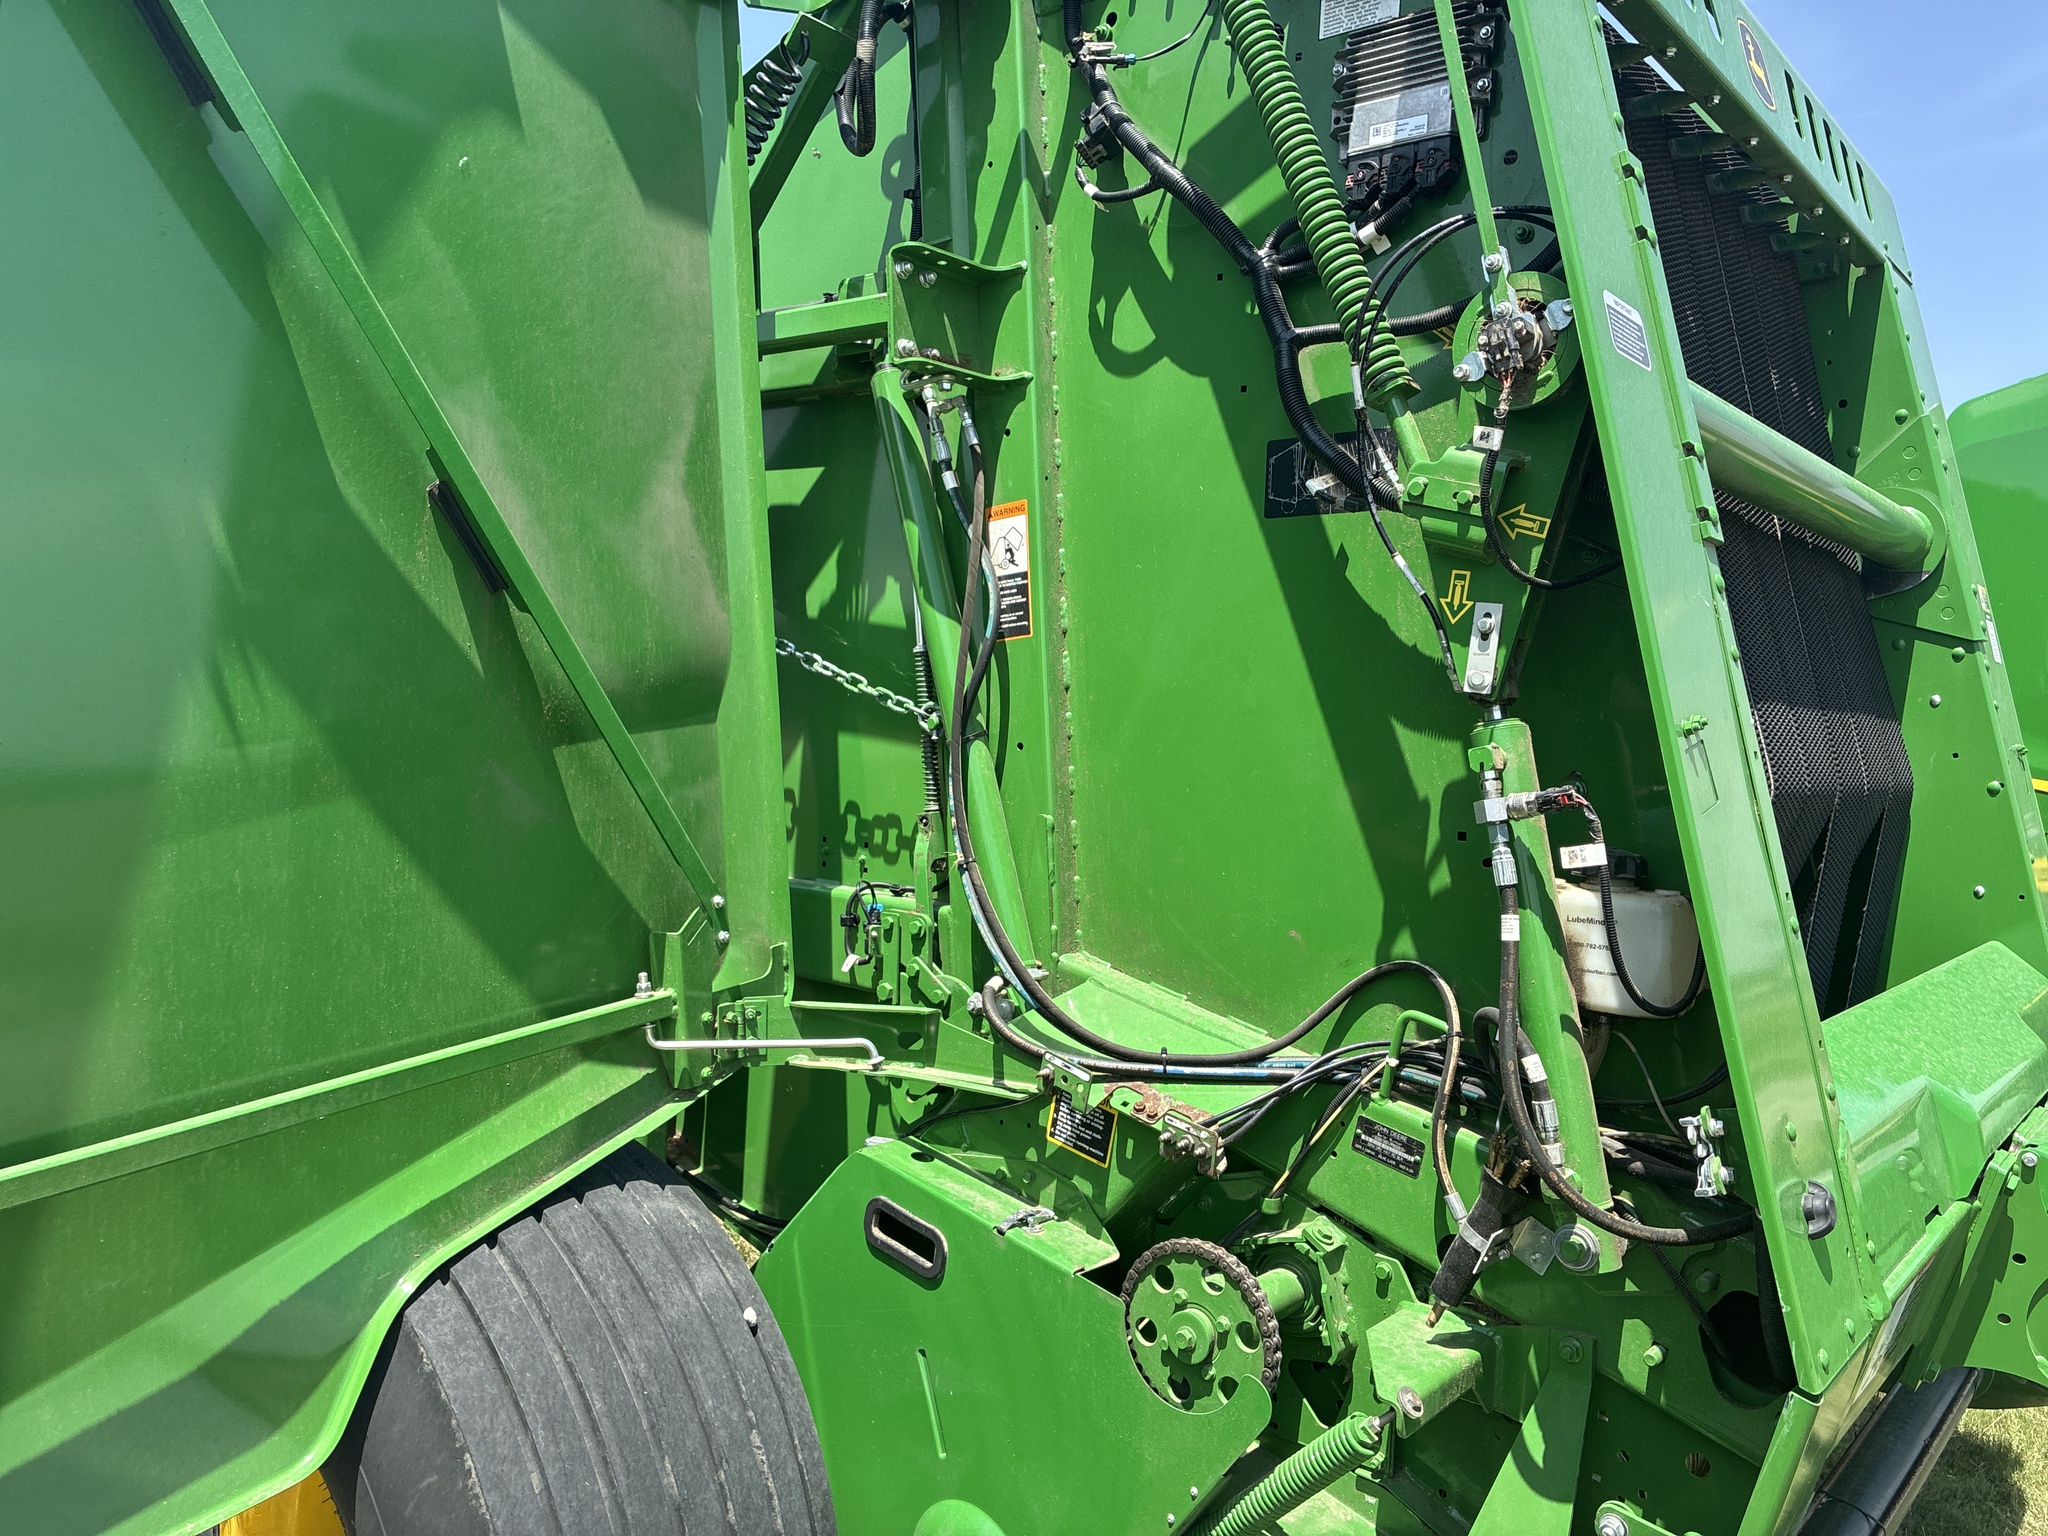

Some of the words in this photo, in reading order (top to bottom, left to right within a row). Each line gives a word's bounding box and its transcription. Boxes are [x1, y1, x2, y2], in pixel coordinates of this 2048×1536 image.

[992, 503, 1025, 517] WARNING
[1566, 914, 1618, 926] LubeMind
[1374, 1123, 1389, 1133] JOHN
[1390, 1130, 1407, 1141] DEERE
